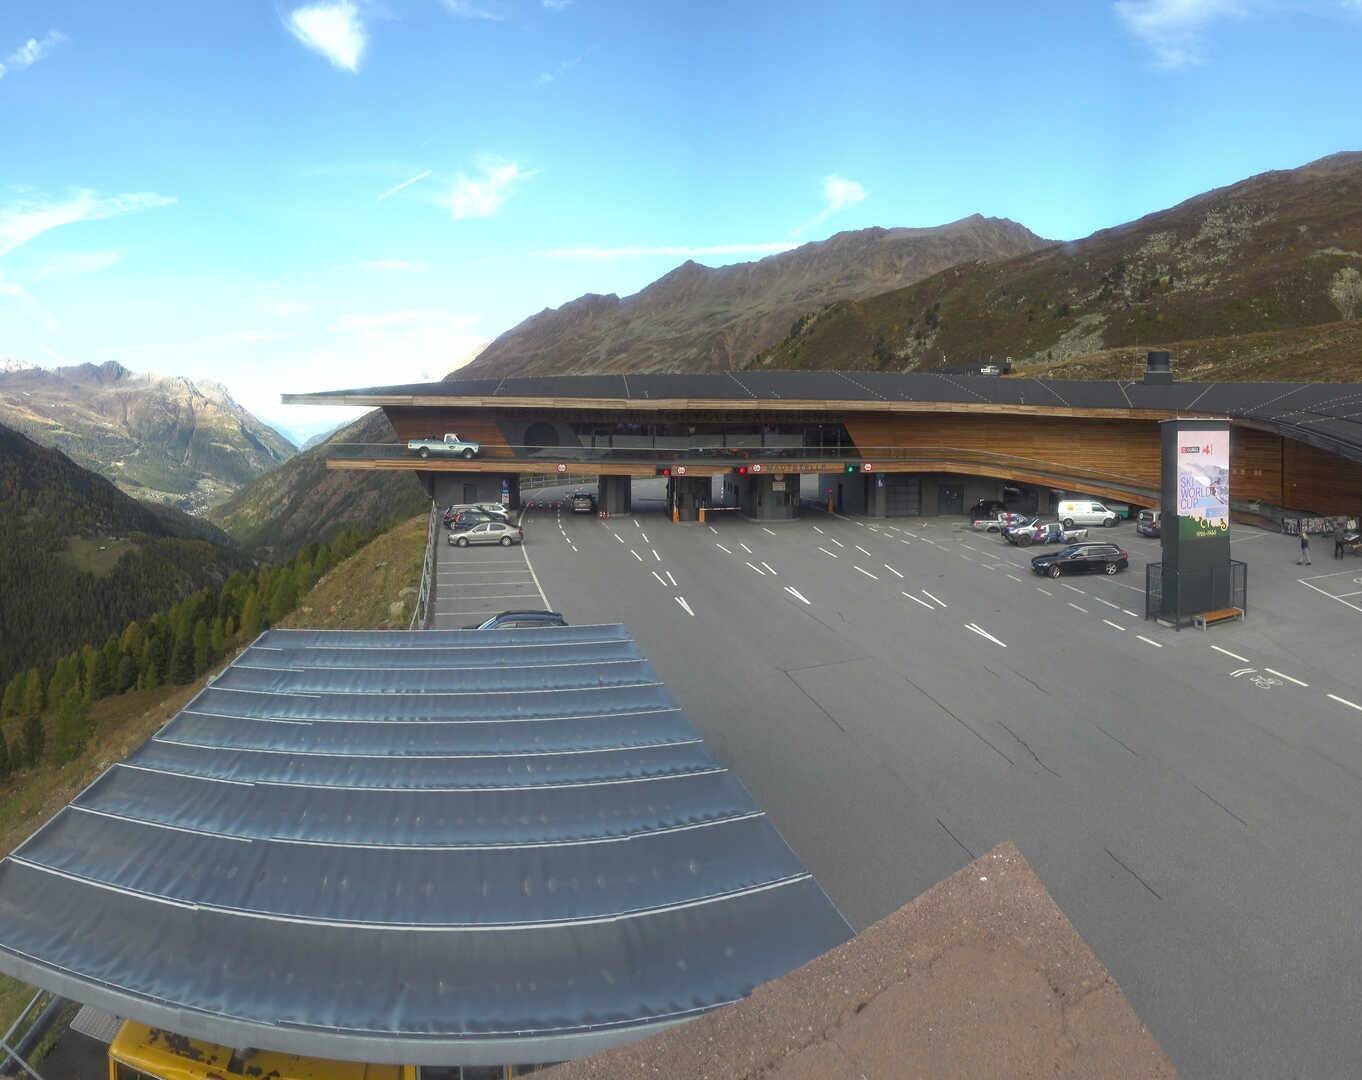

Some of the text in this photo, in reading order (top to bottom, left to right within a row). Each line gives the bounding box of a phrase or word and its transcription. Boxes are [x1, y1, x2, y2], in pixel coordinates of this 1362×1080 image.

[1180, 475, 1193, 487] SKI
[1180, 486, 1211, 498] WORLD
[1180, 498, 1198, 509] CUP
